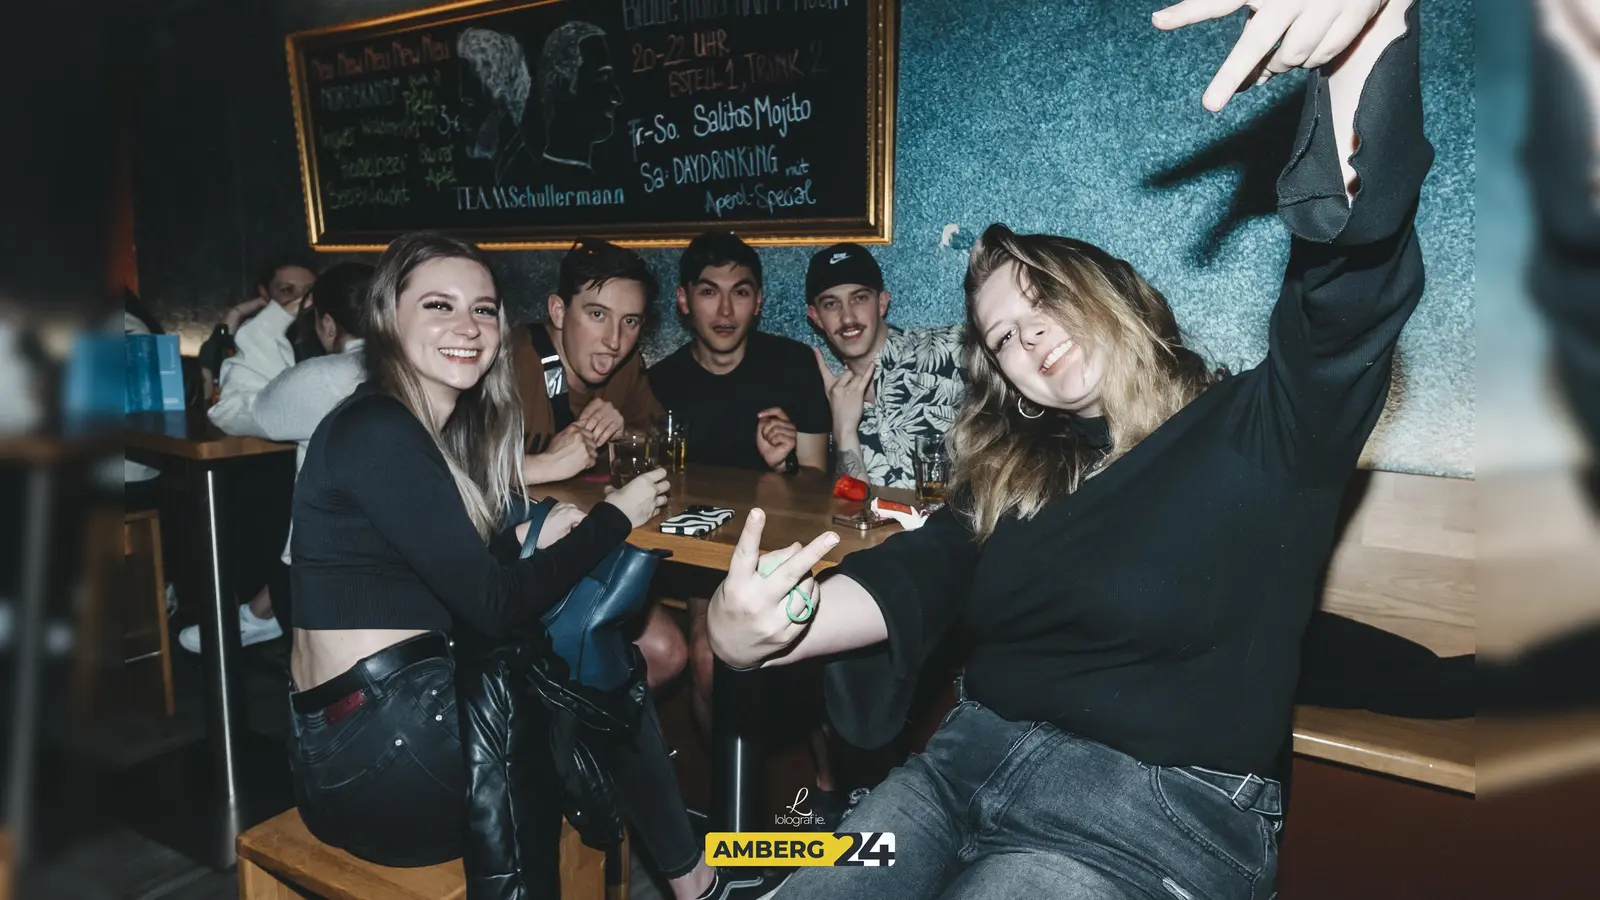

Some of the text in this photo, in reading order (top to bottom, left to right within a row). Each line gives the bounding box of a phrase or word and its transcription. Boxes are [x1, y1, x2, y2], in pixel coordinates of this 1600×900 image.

[694, 29, 732, 58] UHR
[693, 101, 752, 137] Salitos
[754, 92, 811, 137] Mojito
[640, 162, 669, 193] Sa:
[704, 179, 816, 217] Aperol-Special
